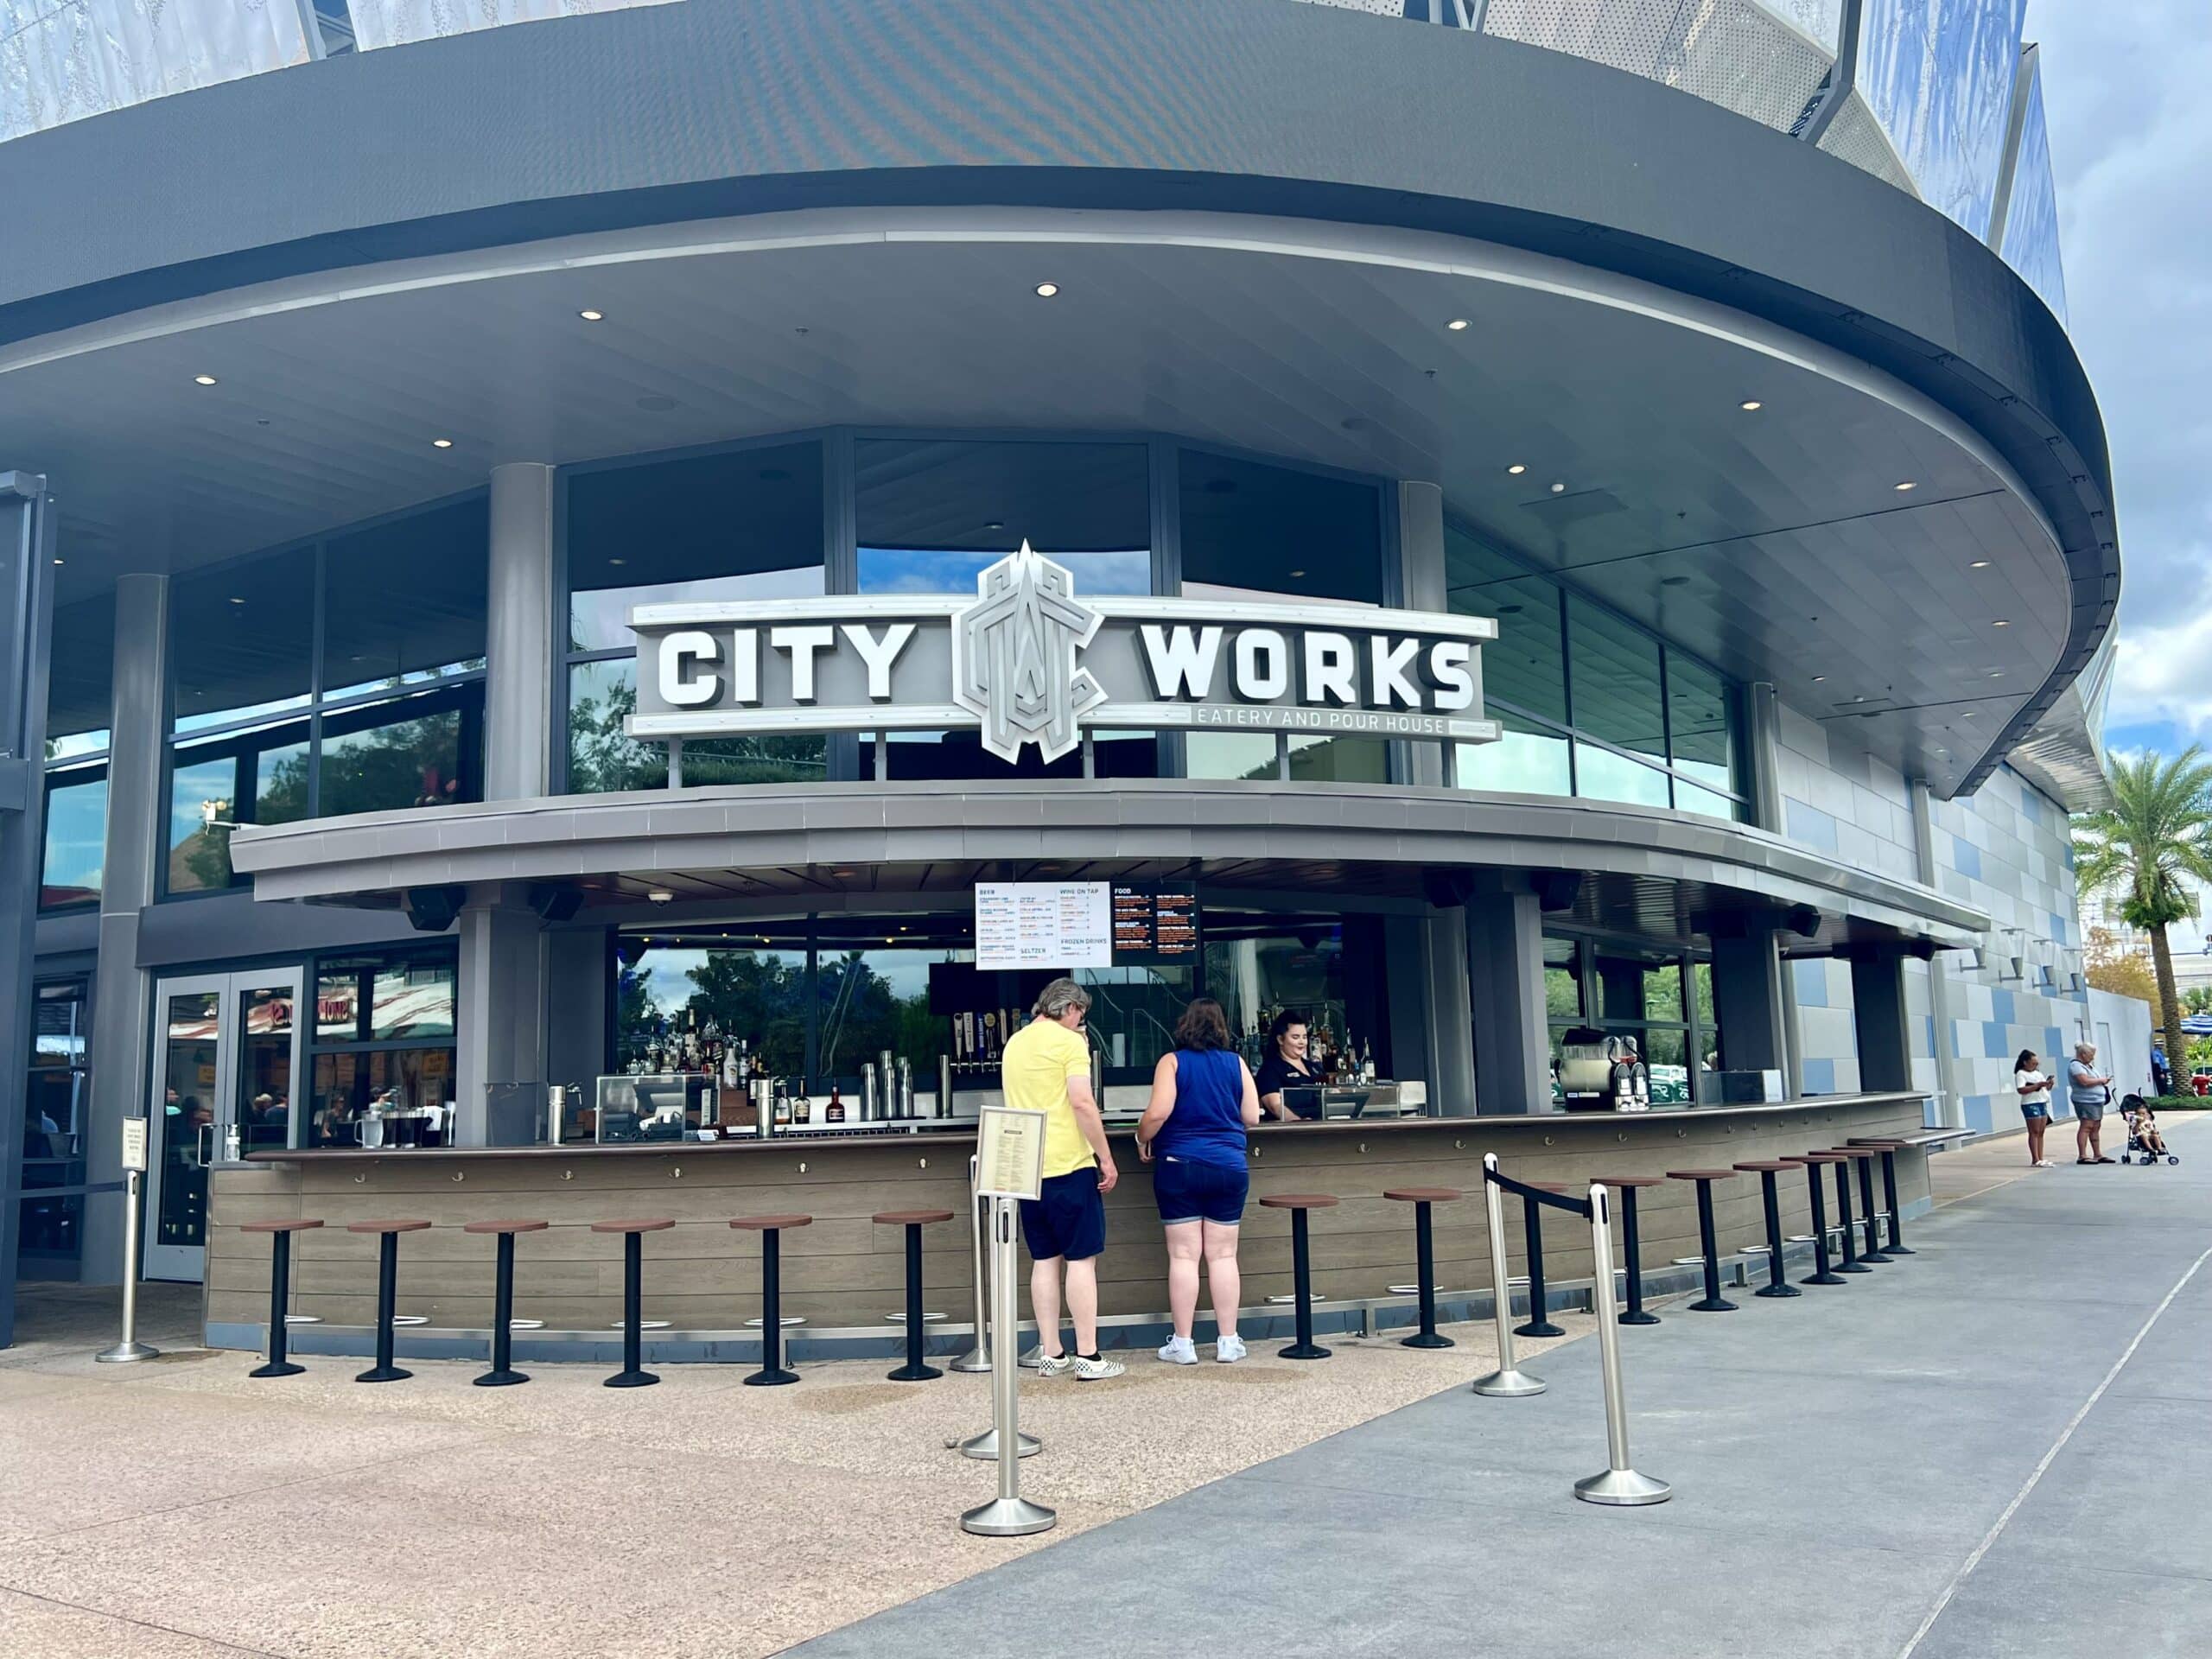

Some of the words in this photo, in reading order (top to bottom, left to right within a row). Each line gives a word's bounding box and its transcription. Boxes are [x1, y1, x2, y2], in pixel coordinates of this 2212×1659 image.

[658, 622, 918, 705] CITY
[1141, 623, 1475, 712] WORKS
[1198, 708, 1273, 725] EATERY
[1281, 711, 1321, 728] AND
[1330, 713, 1379, 730] POUR
[1386, 716, 1444, 734] HOUSE
